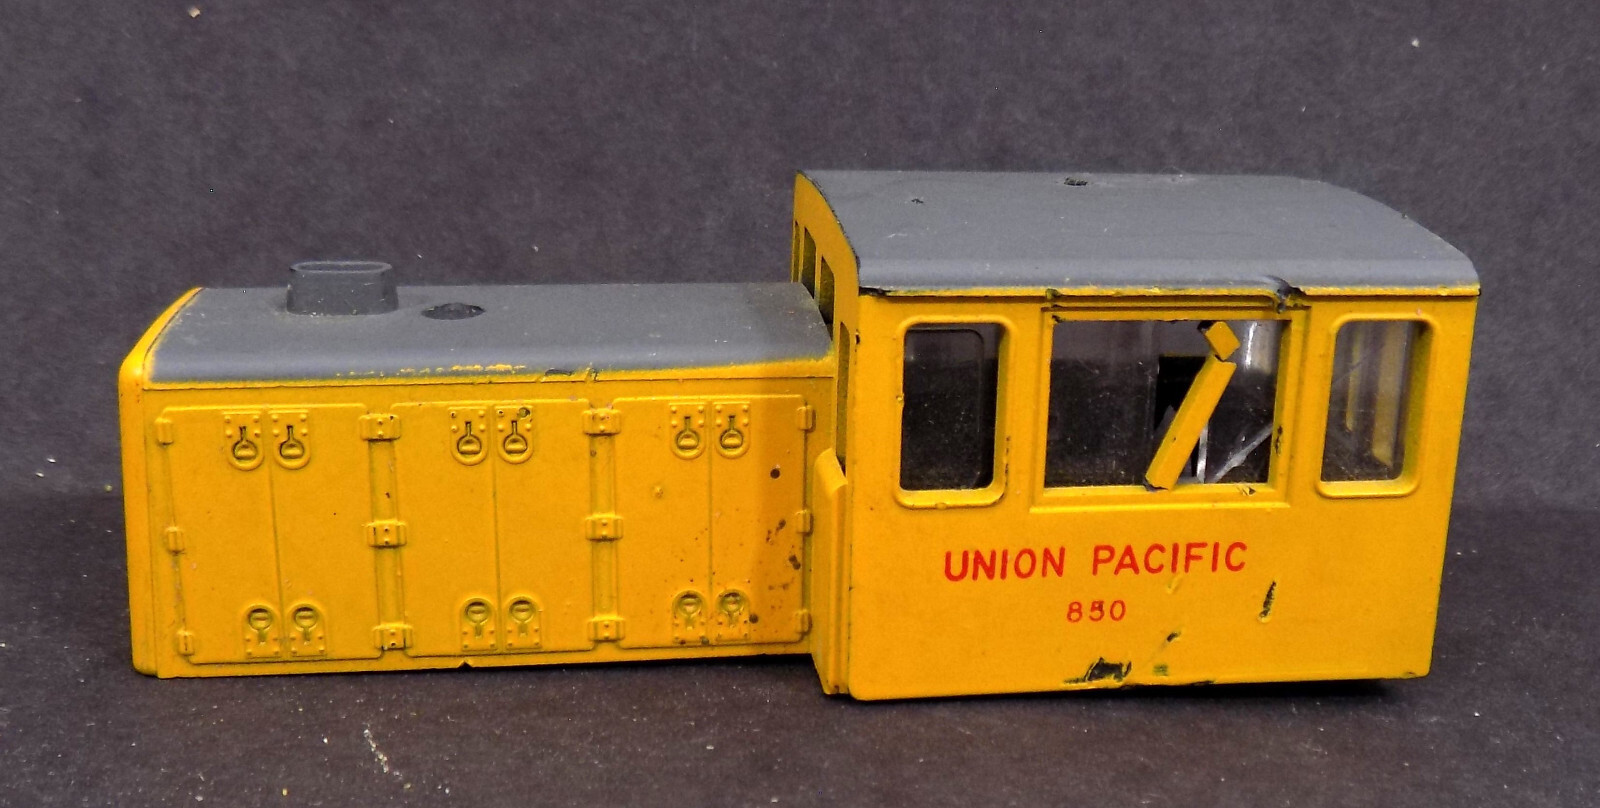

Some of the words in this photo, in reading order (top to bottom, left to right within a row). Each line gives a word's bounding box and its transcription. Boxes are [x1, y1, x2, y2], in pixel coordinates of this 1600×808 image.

[944, 546, 1065, 581] UNION
[1091, 541, 1248, 576] PACIFIC
[1066, 599, 1127, 623] 850
